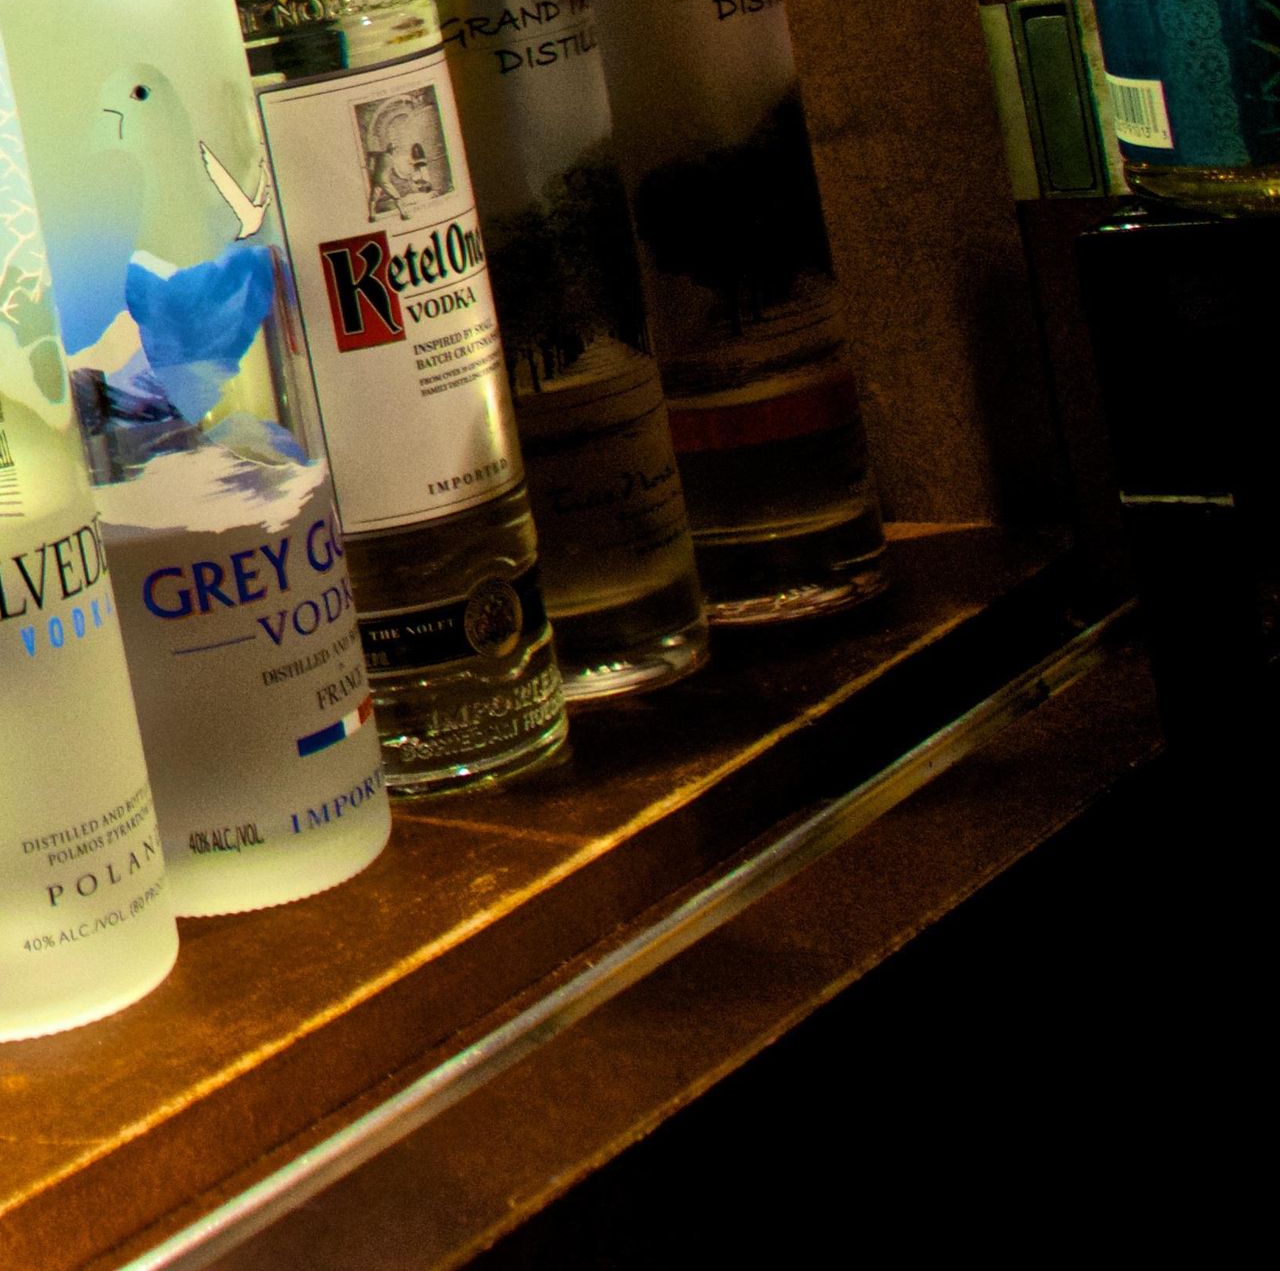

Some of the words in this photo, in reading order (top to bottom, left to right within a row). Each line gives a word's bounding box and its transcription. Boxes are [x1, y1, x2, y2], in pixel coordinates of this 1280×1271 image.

[323, 227, 447, 337] Ketel
[445, 221, 485, 276] One
[406, 287, 478, 326] VODKA
[413, 331, 463, 356] INSPIRED
[416, 351, 453, 371] BATCH
[426, 456, 509, 496] IMPORTED
[142, 536, 291, 622] GREY
[369, 628, 401, 642] THE
[262, 646, 333, 688] DISTILLED
[291, 768, 386, 834] IMPORT
[21, 819, 100, 855] DISTILLED
[101, 805, 126, 827] AND
[189, 827, 209, 855] 40%
[46, 836, 105, 867] POLMOS
[45, 835, 156, 908] POLAN
[22, 935, 57, 953] 40%
